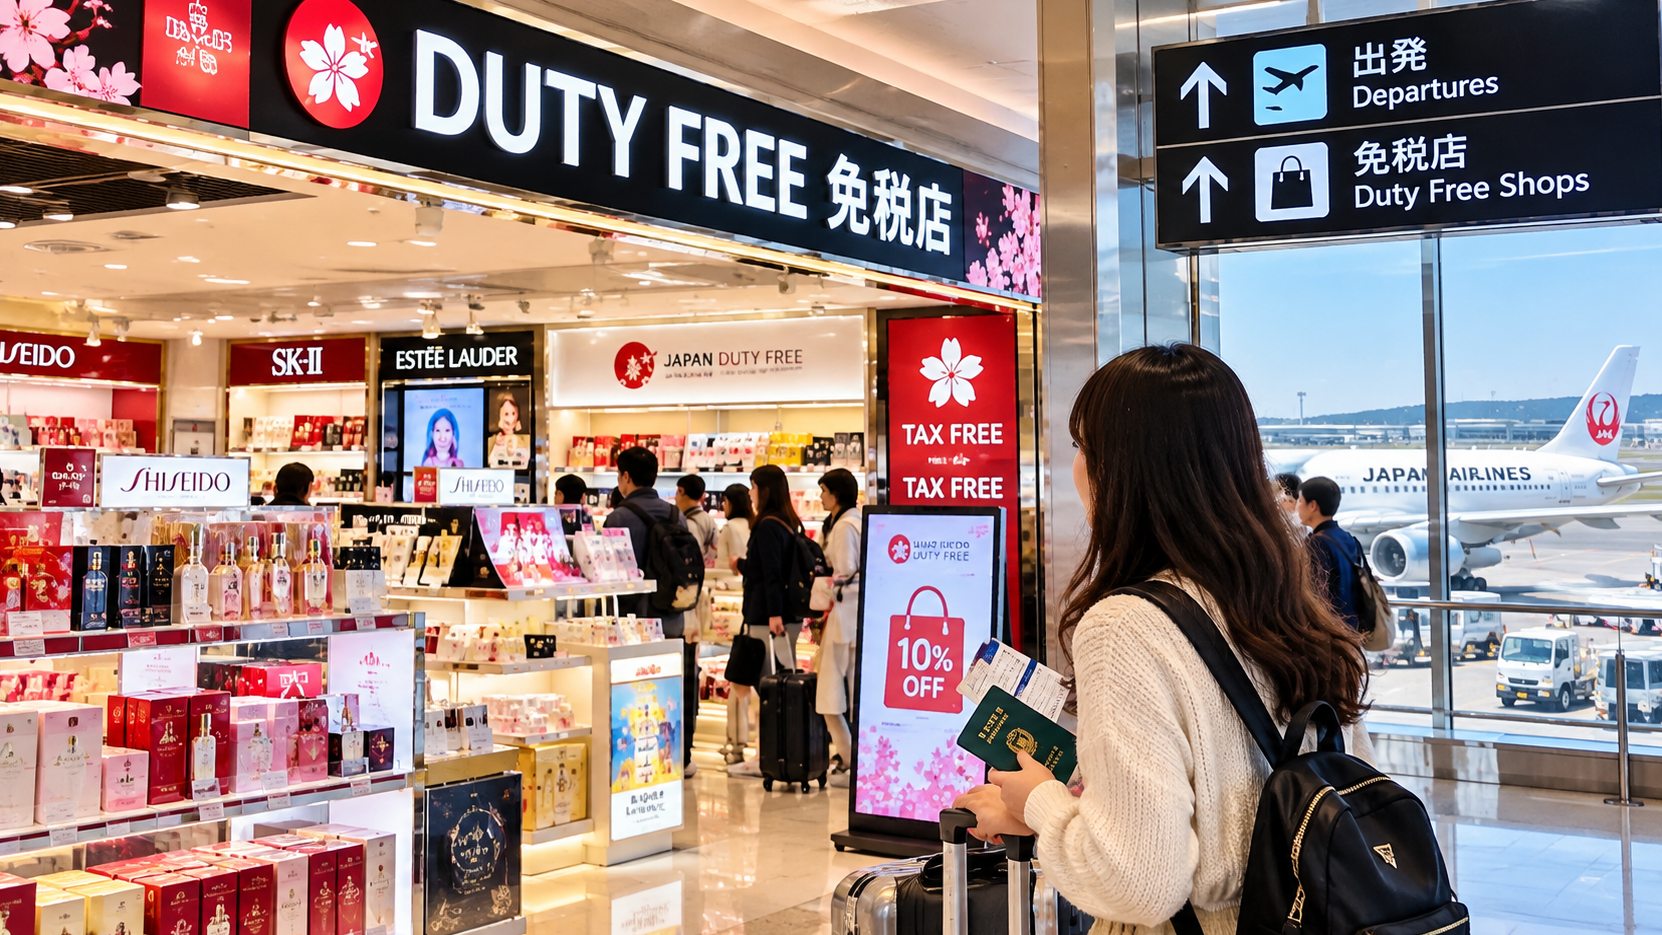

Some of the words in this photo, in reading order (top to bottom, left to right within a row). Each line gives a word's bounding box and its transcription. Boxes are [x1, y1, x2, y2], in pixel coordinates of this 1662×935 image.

[1353, 37, 1427, 78] 出発
[1353, 74, 1499, 110] Departures
[415, 28, 646, 177] DUTY
[665, 104, 807, 219] FREE
[1353, 133, 1467, 177] 免税店
[828, 153, 951, 256] 免税店
[1355, 183, 1420, 211] Duty
[1430, 178, 1490, 203] Free
[1499, 171, 1590, 200] Shops
[271, 346, 323, 377] SK-II
[448, 345, 518, 368] LAUDER
[664, 352, 713, 367] JAPAN
[718, 350, 761, 366] DUTY
[765, 349, 803, 364] FREE
[902, 423, 944, 445] TAX
[950, 422, 1004, 445] FREE
[120, 467, 231, 492] SHISEIDO
[902, 476, 945, 499] TAX
[950, 476, 1004, 499] FREE
[943, 551, 970, 562] FREE
[897, 637, 953, 672] 10%
[902, 675, 945, 699] OFF
